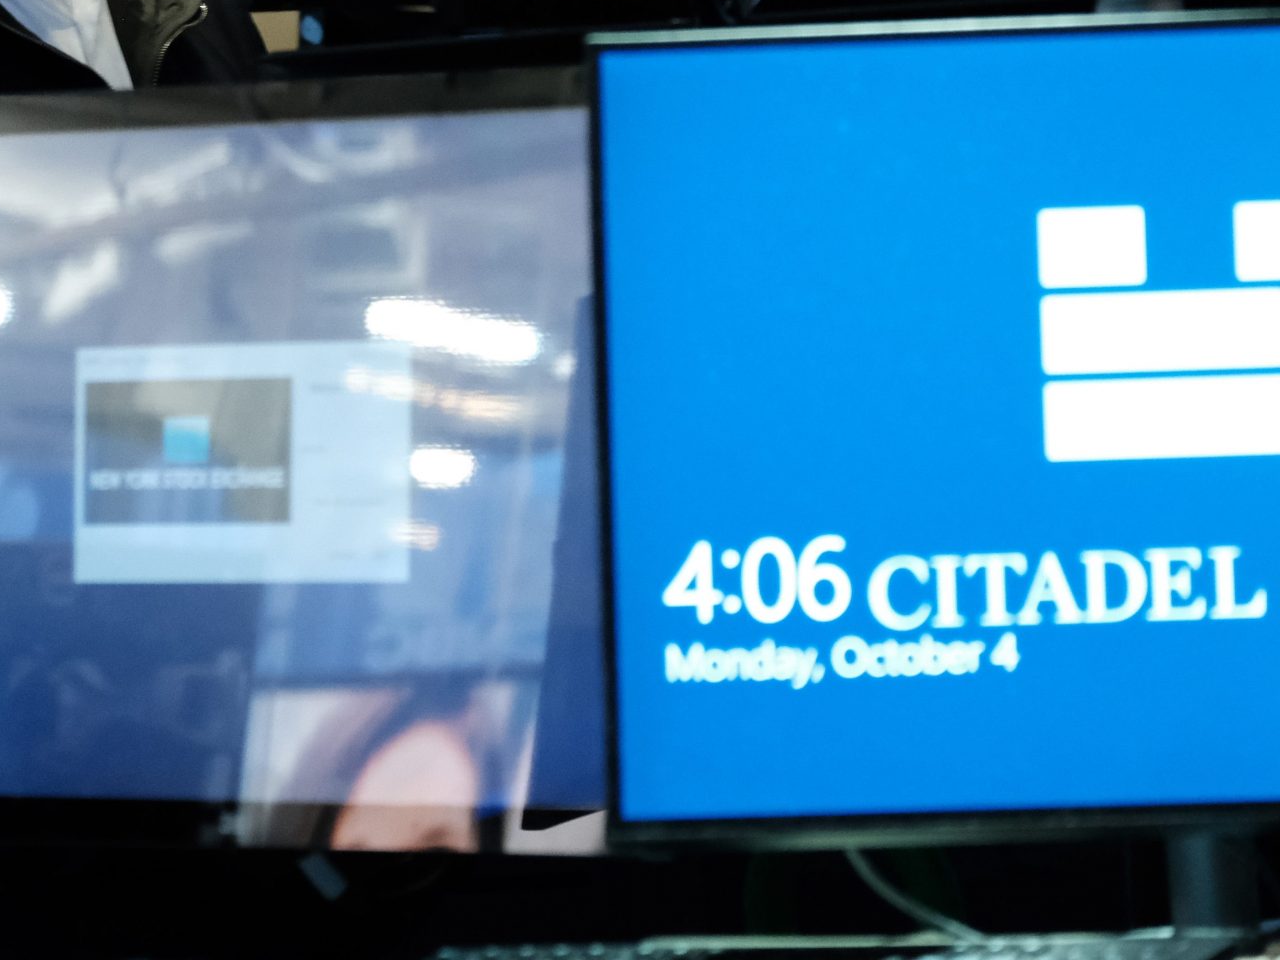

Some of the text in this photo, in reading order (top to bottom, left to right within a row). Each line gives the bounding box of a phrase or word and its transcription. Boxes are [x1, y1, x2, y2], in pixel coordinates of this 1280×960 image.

[662, 534, 852, 625] 4:06
[867, 545, 1269, 631] CITADEL
[664, 632, 1020, 690] Monday, October 4
